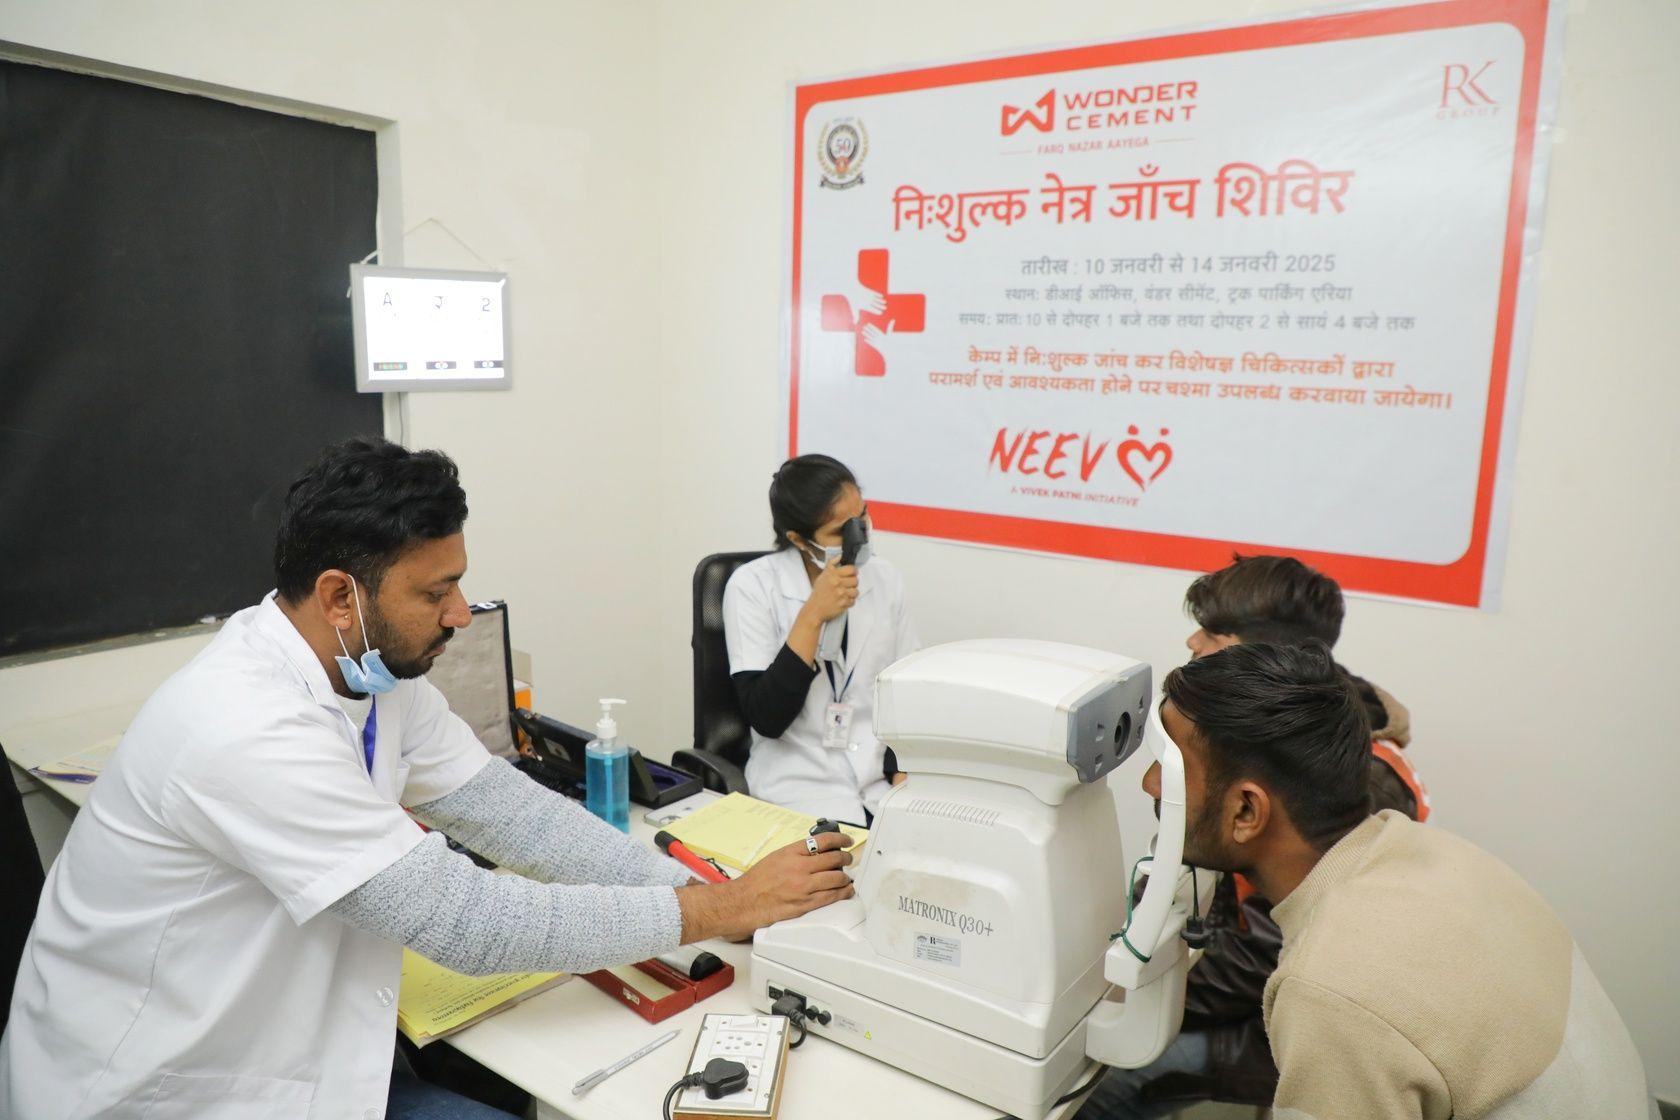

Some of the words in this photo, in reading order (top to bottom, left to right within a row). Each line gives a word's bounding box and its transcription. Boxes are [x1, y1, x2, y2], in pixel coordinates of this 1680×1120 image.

[1063, 81, 1198, 110] WONDER
[1440, 61, 1498, 107] RK
[1066, 105, 1197, 131] CEMENT
[1068, 140, 1103, 152] NAZAR
[1107, 136, 1150, 150] AAYEGA
[1040, 173, 1097, 223] नेत्र
[1214, 159, 1356, 218] शिविर
[1021, 255, 1069, 275] तारीख
[1086, 259, 1105, 274] 10
[1110, 255, 1164, 274] जनवरी
[1169, 253, 1185, 273] से
[1192, 257, 1213, 273] 14
[1219, 251, 1280, 273] जनवरी
[1284, 254, 1336, 272] 2025
[383, 292, 393, 307] A
[482, 297, 491, 312] 2
[1311, 282, 1354, 301] एरिया
[1027, 313, 1042, 325] 10
[1046, 310, 1057, 325] से
[1062, 310, 1100, 328] दोपहर
[1119, 311, 1142, 326] बजे
[1147, 312, 1171, 326] तक
[1176, 313, 1204, 327] तथा
[1210, 311, 1254, 331] दोपहर
[1258, 315, 1271, 330] 2
[1277, 311, 1292, 329] से
[1333, 315, 1346, 330] 4
[1352, 312, 1379, 331] बजे
[1385, 315, 1416, 331] तक
[1007, 346, 1018, 364] में
[1094, 349, 1129, 369] जांच
[1134, 355, 1165, 371] कर
[1169, 350, 1234, 374] विशेषज्ञ
[1240, 352, 1346, 376] चिकित्सकों
[1351, 361, 1395, 380] द्वारा
[929, 369, 979, 388] परामर्श
[983, 370, 1003, 390] एवं
[1009, 374, 1096, 393] आवश्यकता
[1101, 373, 1133, 395] होने
[1139, 381, 1163, 395] पर
[1166, 381, 1211, 397] चश्मा
[1217, 382, 1282, 400] उपलब्ध
[1288, 387, 1367, 406] करवाया
[987, 427, 1111, 483] NEEV
[1020, 487, 1050, 498] VIVEK
[1084, 493, 1140, 507] INITIATIVE
[898, 895, 958, 927] MATRONIX
[958, 913, 994, 936] Q30+
